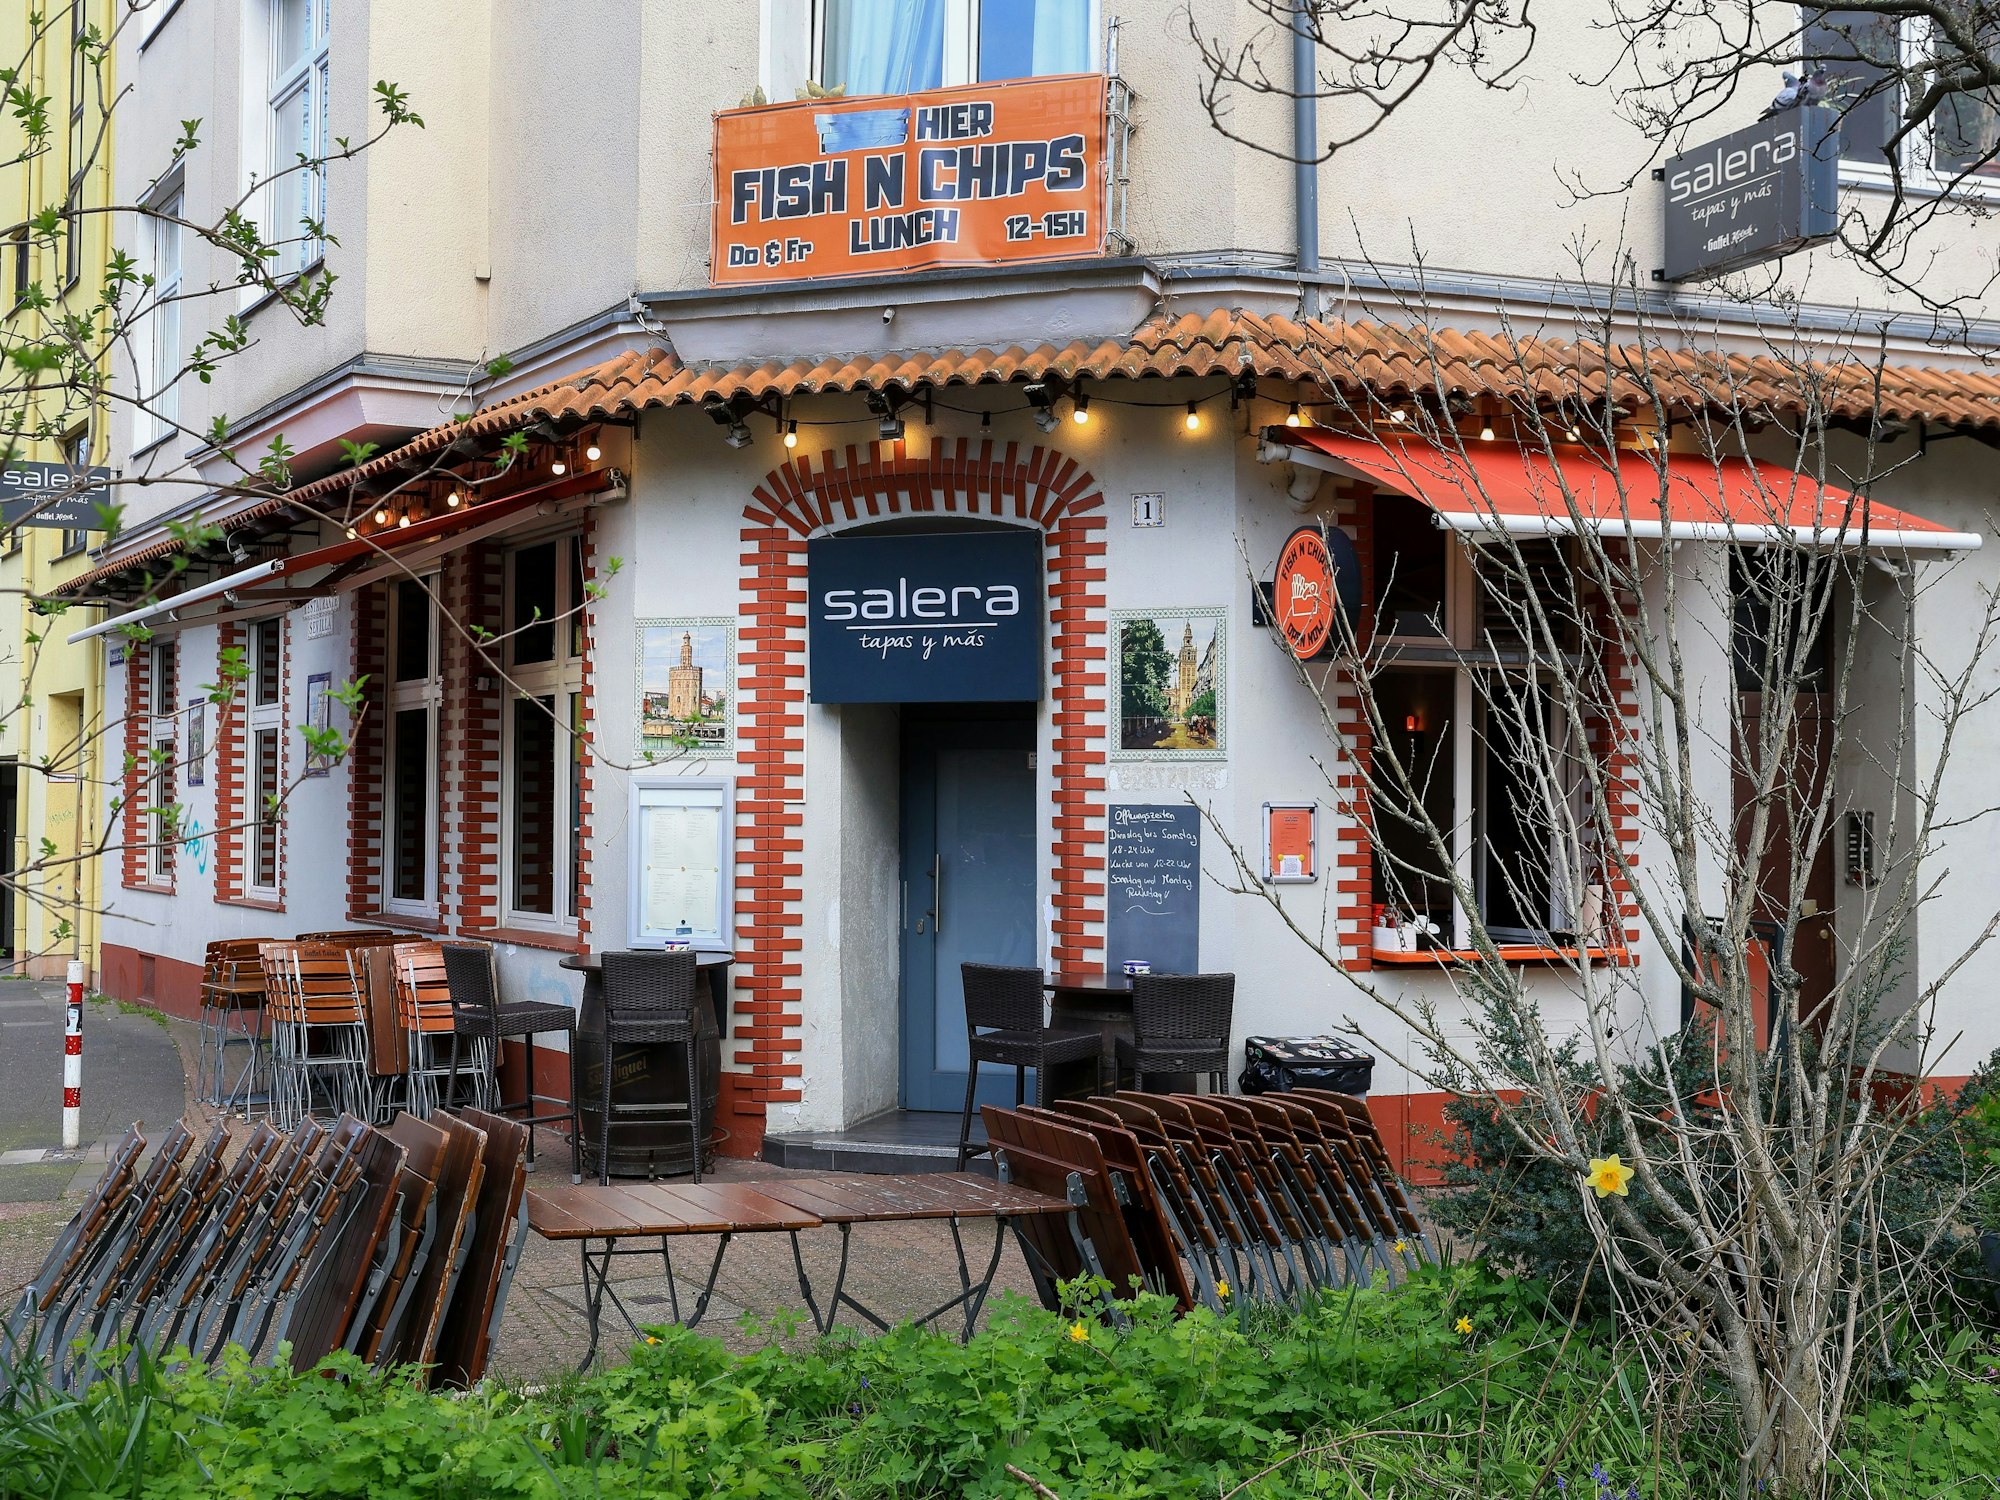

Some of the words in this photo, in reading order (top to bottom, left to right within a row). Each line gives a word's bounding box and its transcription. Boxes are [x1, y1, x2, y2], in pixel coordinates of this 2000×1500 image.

[915, 101, 994, 142] HIER
[731, 158, 848, 225] FISH
[864, 153, 905, 212] N
[918, 134, 1086, 202] CHIPS
[1670, 131, 1795, 202] salera
[1691, 198, 1725, 228] tapas
[1731, 196, 1741, 219] y
[1744, 180, 1772, 203] más
[728, 243, 760, 268] Do
[764, 241, 782, 267] &
[785, 238, 814, 264] Fr
[849, 208, 960, 256] LUNCH
[1004, 211, 1086, 243] 12-15H
[1707, 233, 1730, 252] Gaffel
[3, 467, 106, 491] salera
[1144, 501, 1152, 519] 1
[1281, 548, 1298, 581] FISH
[1299, 541, 1305, 556] N
[824, 577, 1020, 620] salera
[859, 633, 913, 659] tapas
[922, 635, 937, 660] y
[943, 628, 985, 648] más
[1143, 827, 1158, 838] bis
[1140, 846, 1156, 855] Uhr
[1176, 860, 1192, 869] Uhr
[1143, 875, 1156, 885] und
[1162, 874, 1192, 891] Montag
